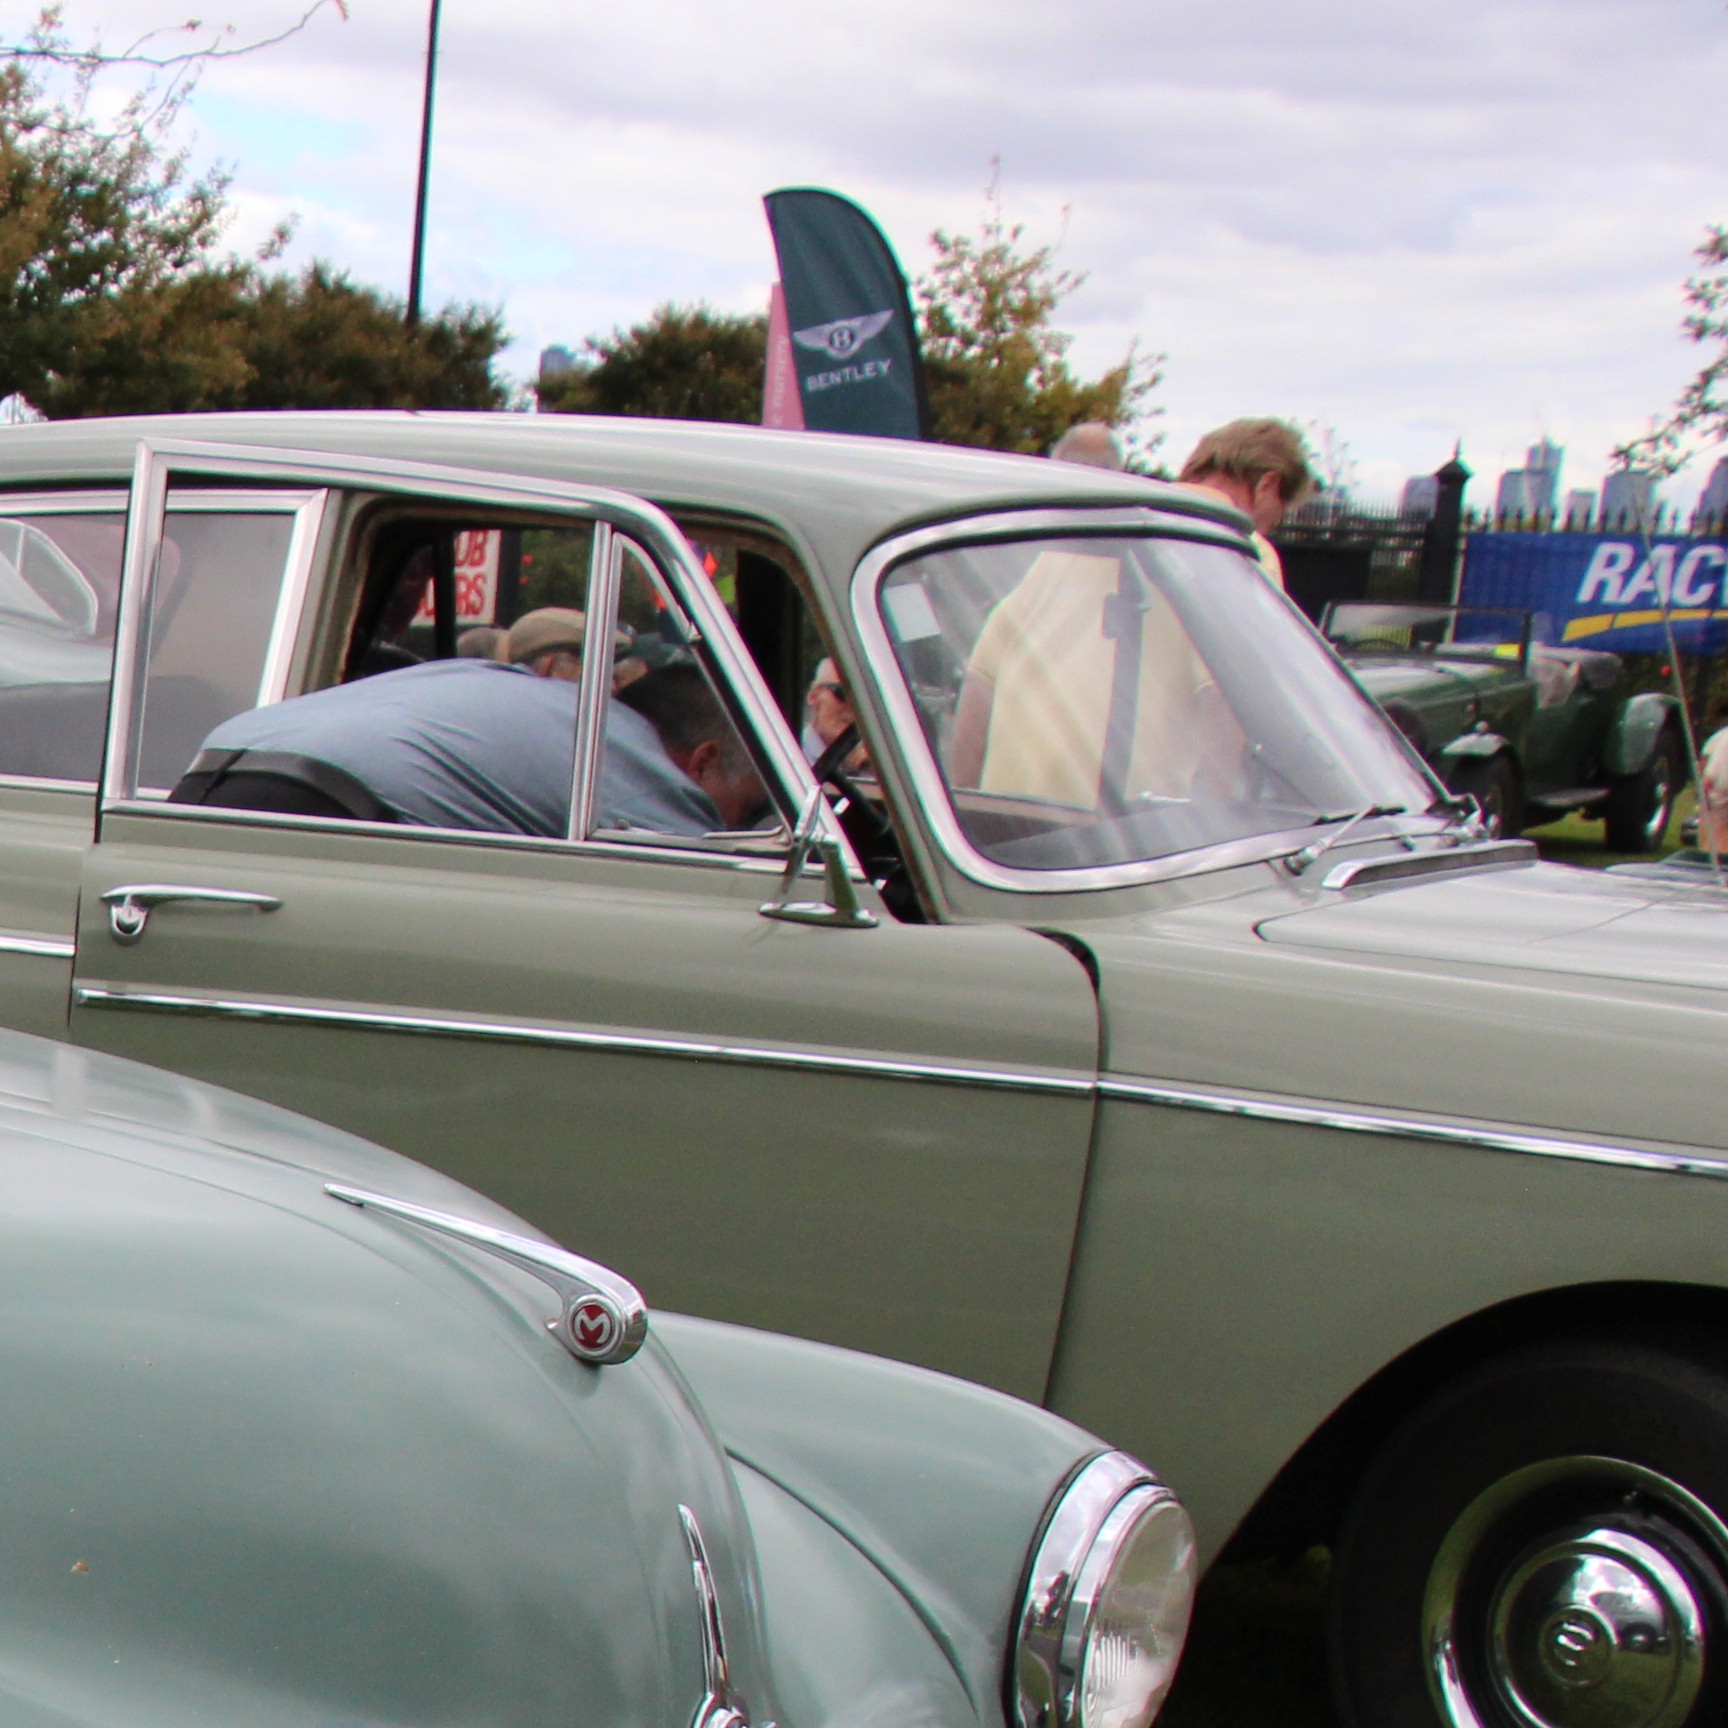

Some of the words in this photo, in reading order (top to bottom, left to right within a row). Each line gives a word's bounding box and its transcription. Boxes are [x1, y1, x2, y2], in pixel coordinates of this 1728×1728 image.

[805, 358, 892, 393] BENTLEY
[1575, 541, 1728, 606] RAC
[574, 1307, 612, 1344] M
